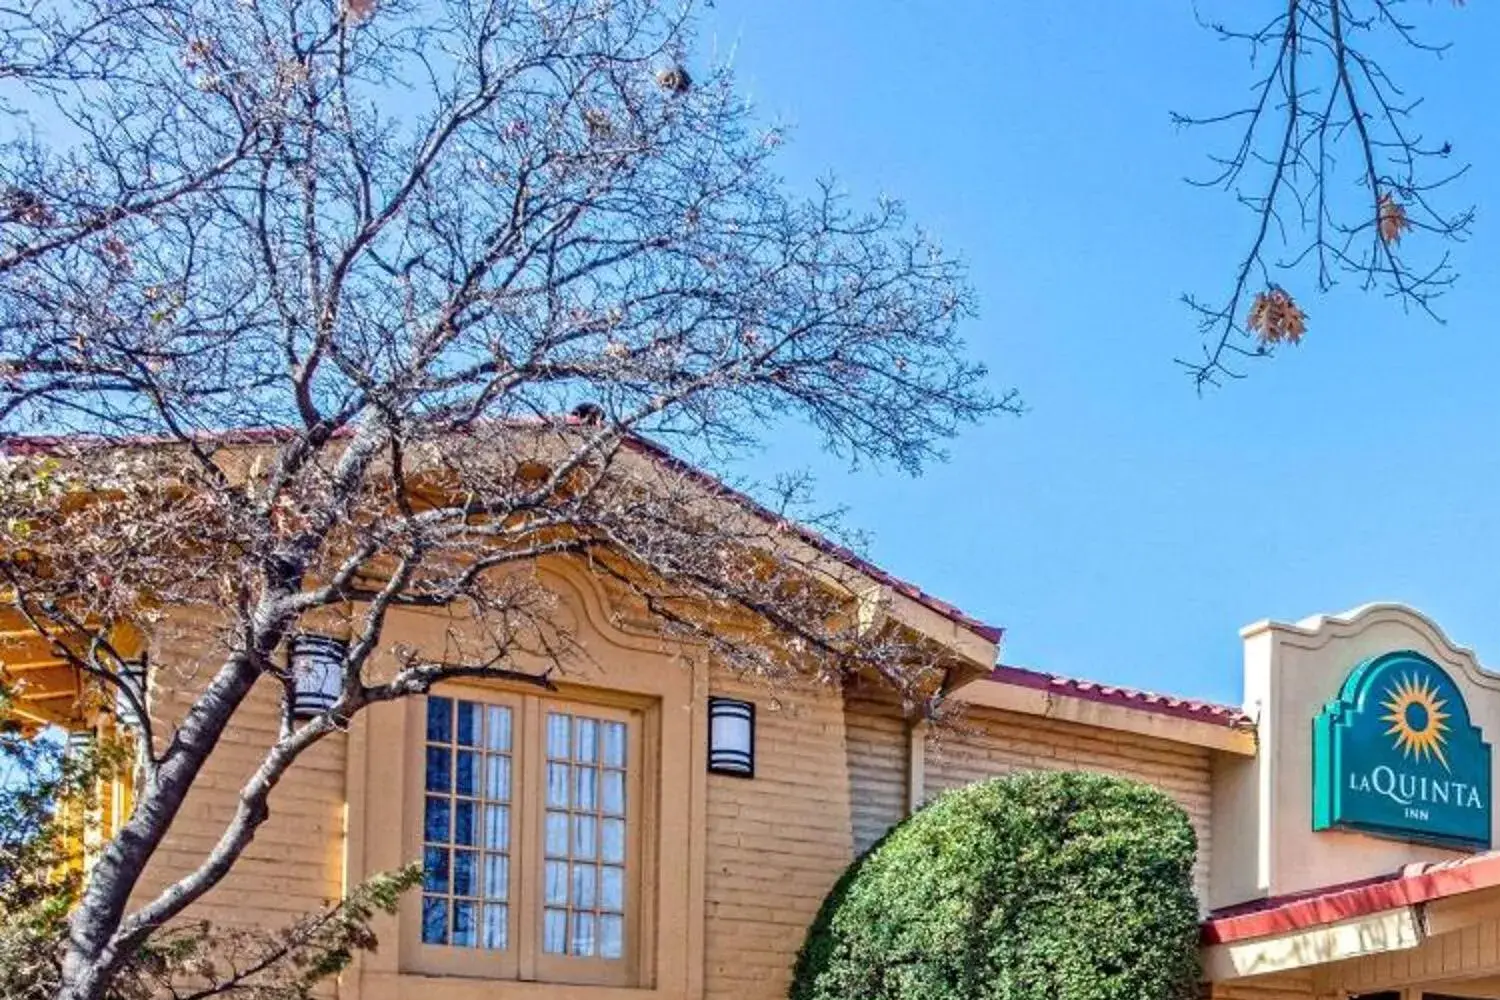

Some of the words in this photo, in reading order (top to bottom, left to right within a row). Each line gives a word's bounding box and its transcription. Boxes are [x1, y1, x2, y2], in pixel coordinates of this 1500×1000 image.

[1349, 772, 1371, 792] LA
[1371, 765, 1484, 809] QUINTA
[1404, 807, 1429, 821] INN
